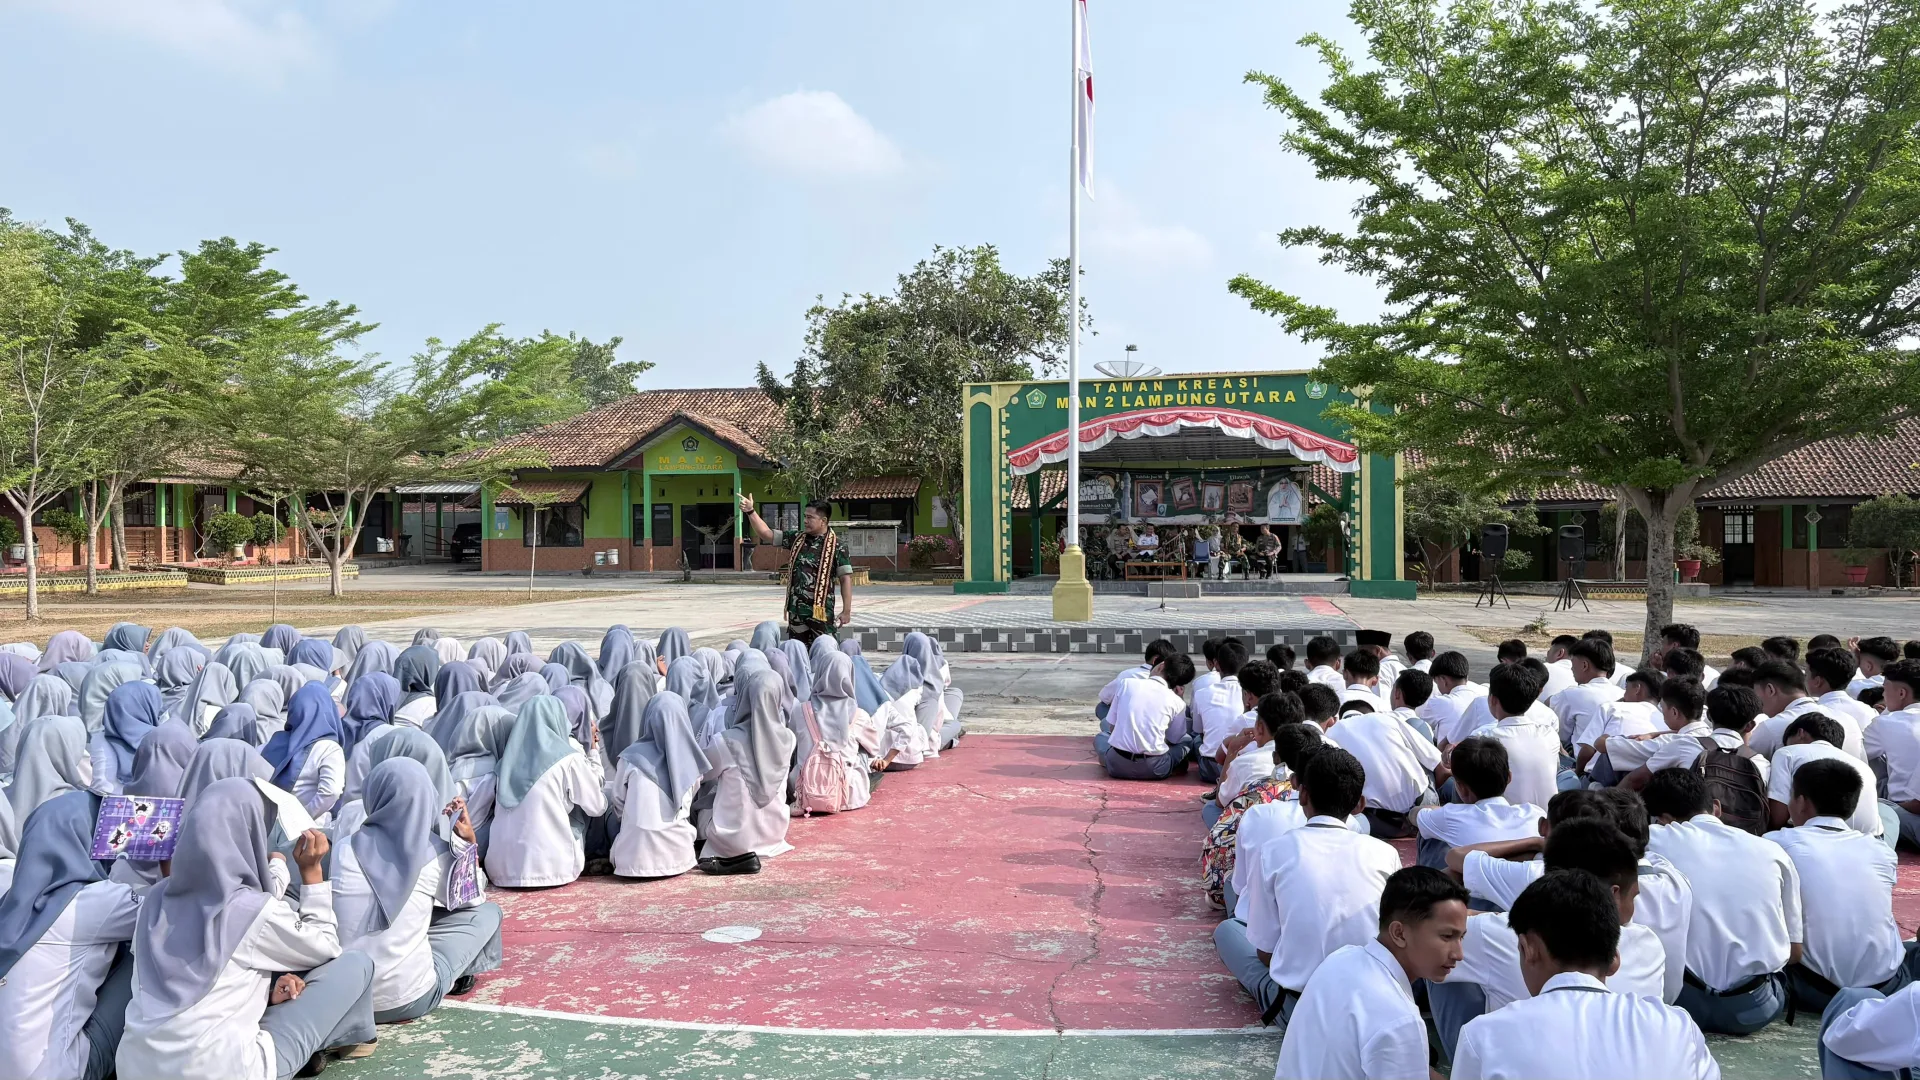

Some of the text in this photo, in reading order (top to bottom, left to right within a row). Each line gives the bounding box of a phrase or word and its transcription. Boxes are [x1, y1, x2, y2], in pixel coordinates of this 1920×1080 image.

[1093, 377, 1258, 393] TAMAN KREASI
[1104, 396, 1114, 408] 2
[1121, 392, 1216, 408] LAMPUNG
[1225, 390, 1296, 404] UTARA
[658, 455, 723, 464] MAN 2
[696, 463, 724, 471] UTARA
[1079, 485, 1114, 497] OMBA
